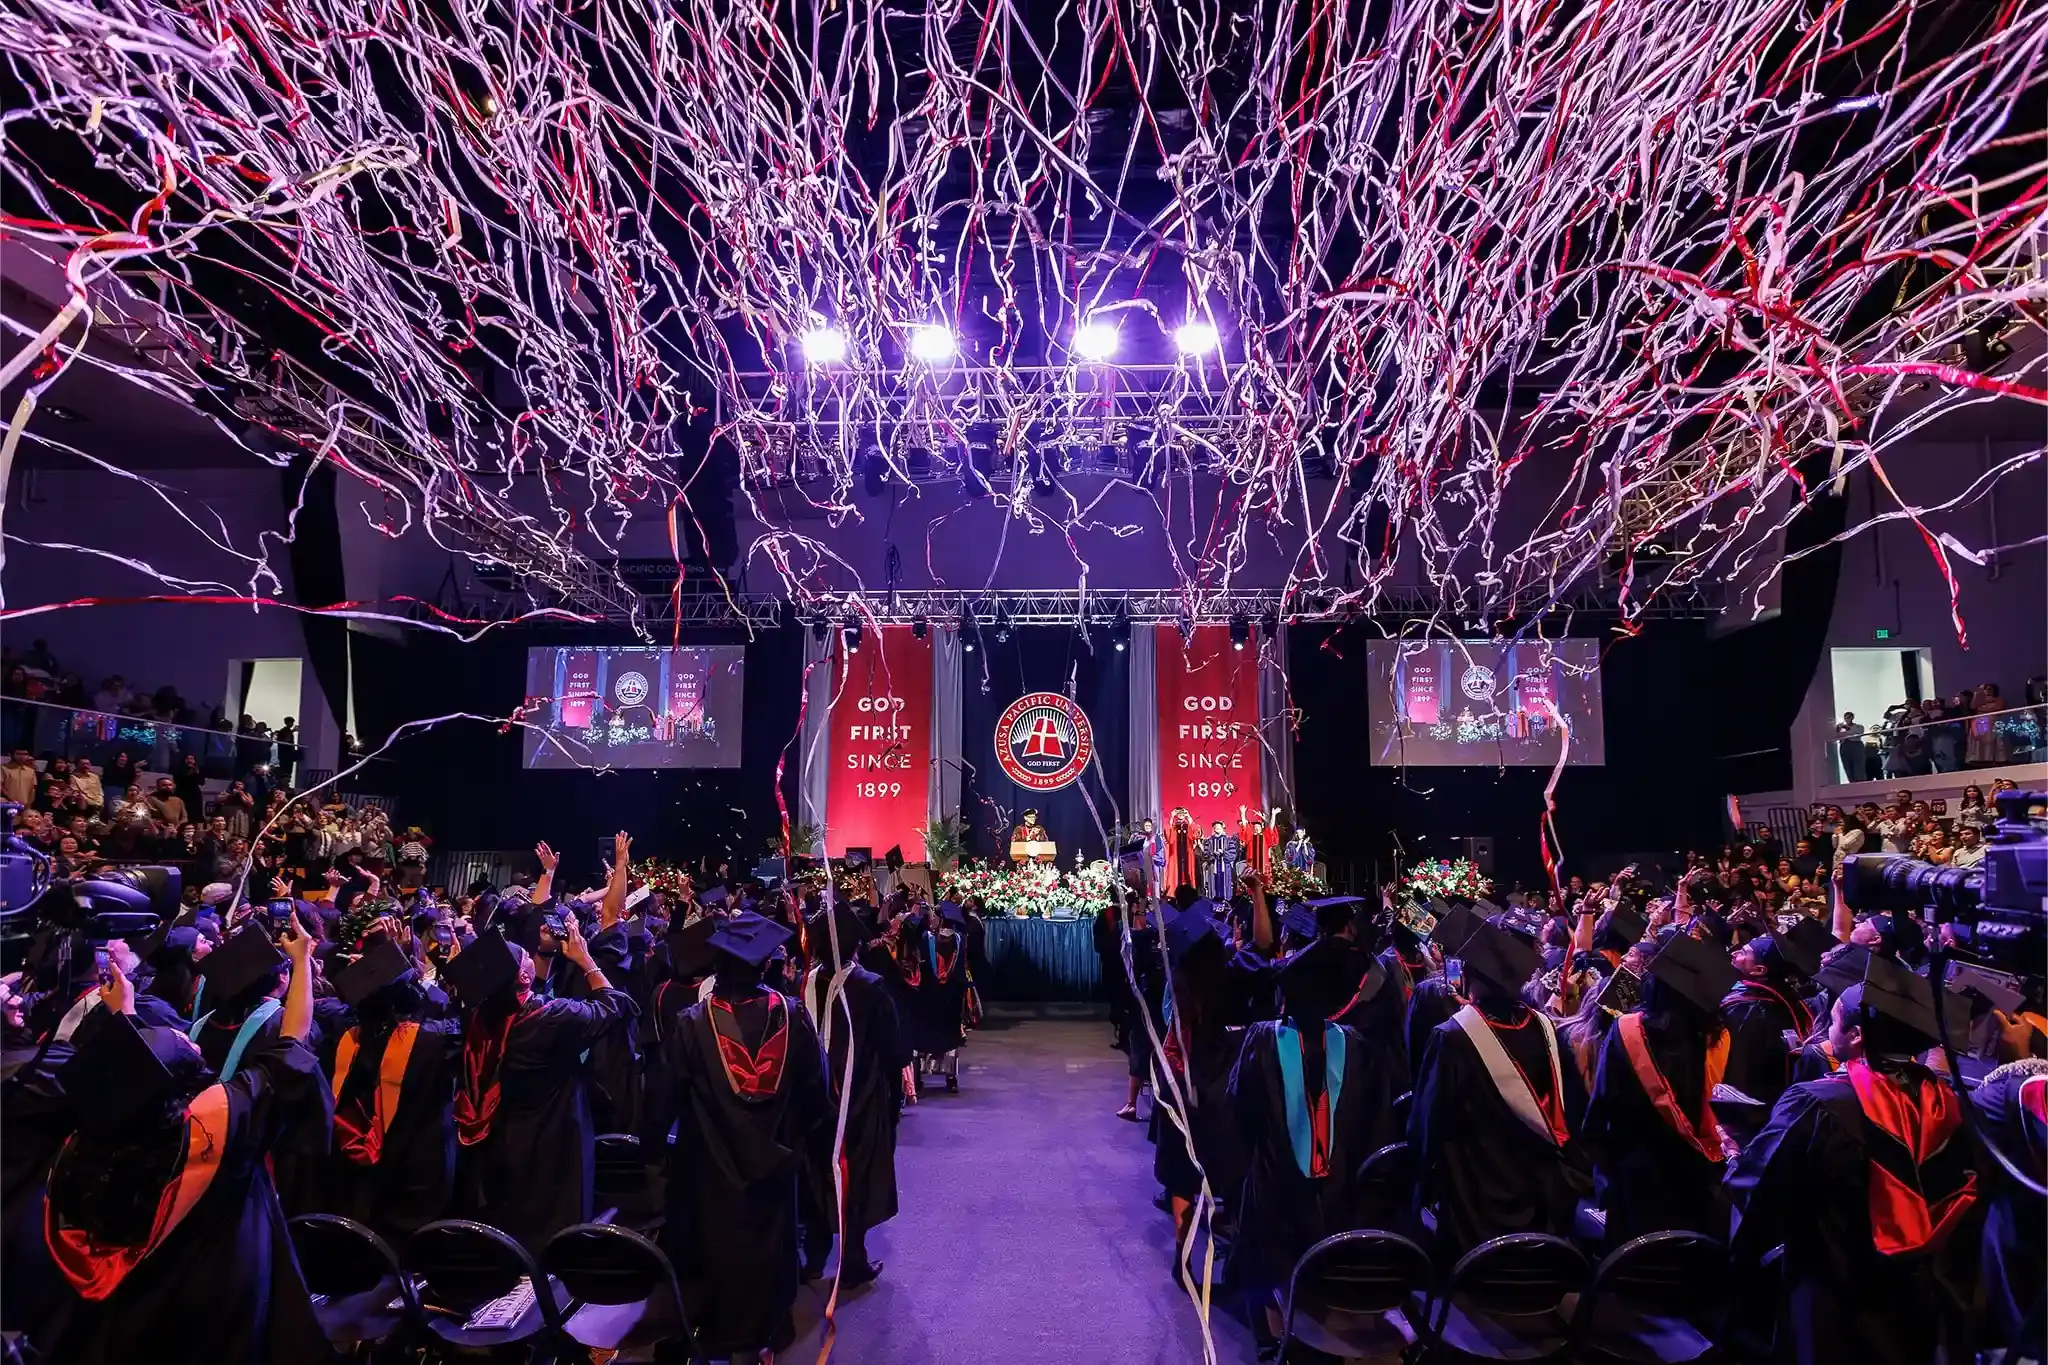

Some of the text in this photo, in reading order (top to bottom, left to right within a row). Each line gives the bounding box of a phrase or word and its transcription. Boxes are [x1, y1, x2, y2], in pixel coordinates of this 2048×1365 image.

[1876, 629, 1888, 639] EXIT
[857, 697, 905, 712] GOD
[1183, 696, 1233, 711] GOD
[850, 725, 912, 740] FIRST
[998, 695, 1090, 764] AZUSA PACIFIC UNVERSITY
[1179, 724, 1241, 740] FIRST
[847, 753, 912, 769] SINCE
[1178, 753, 1243, 769] SINCE
[1033, 777, 1054, 785] 1899
[856, 782, 901, 798] 1899
[1188, 782, 1235, 797] 1899
